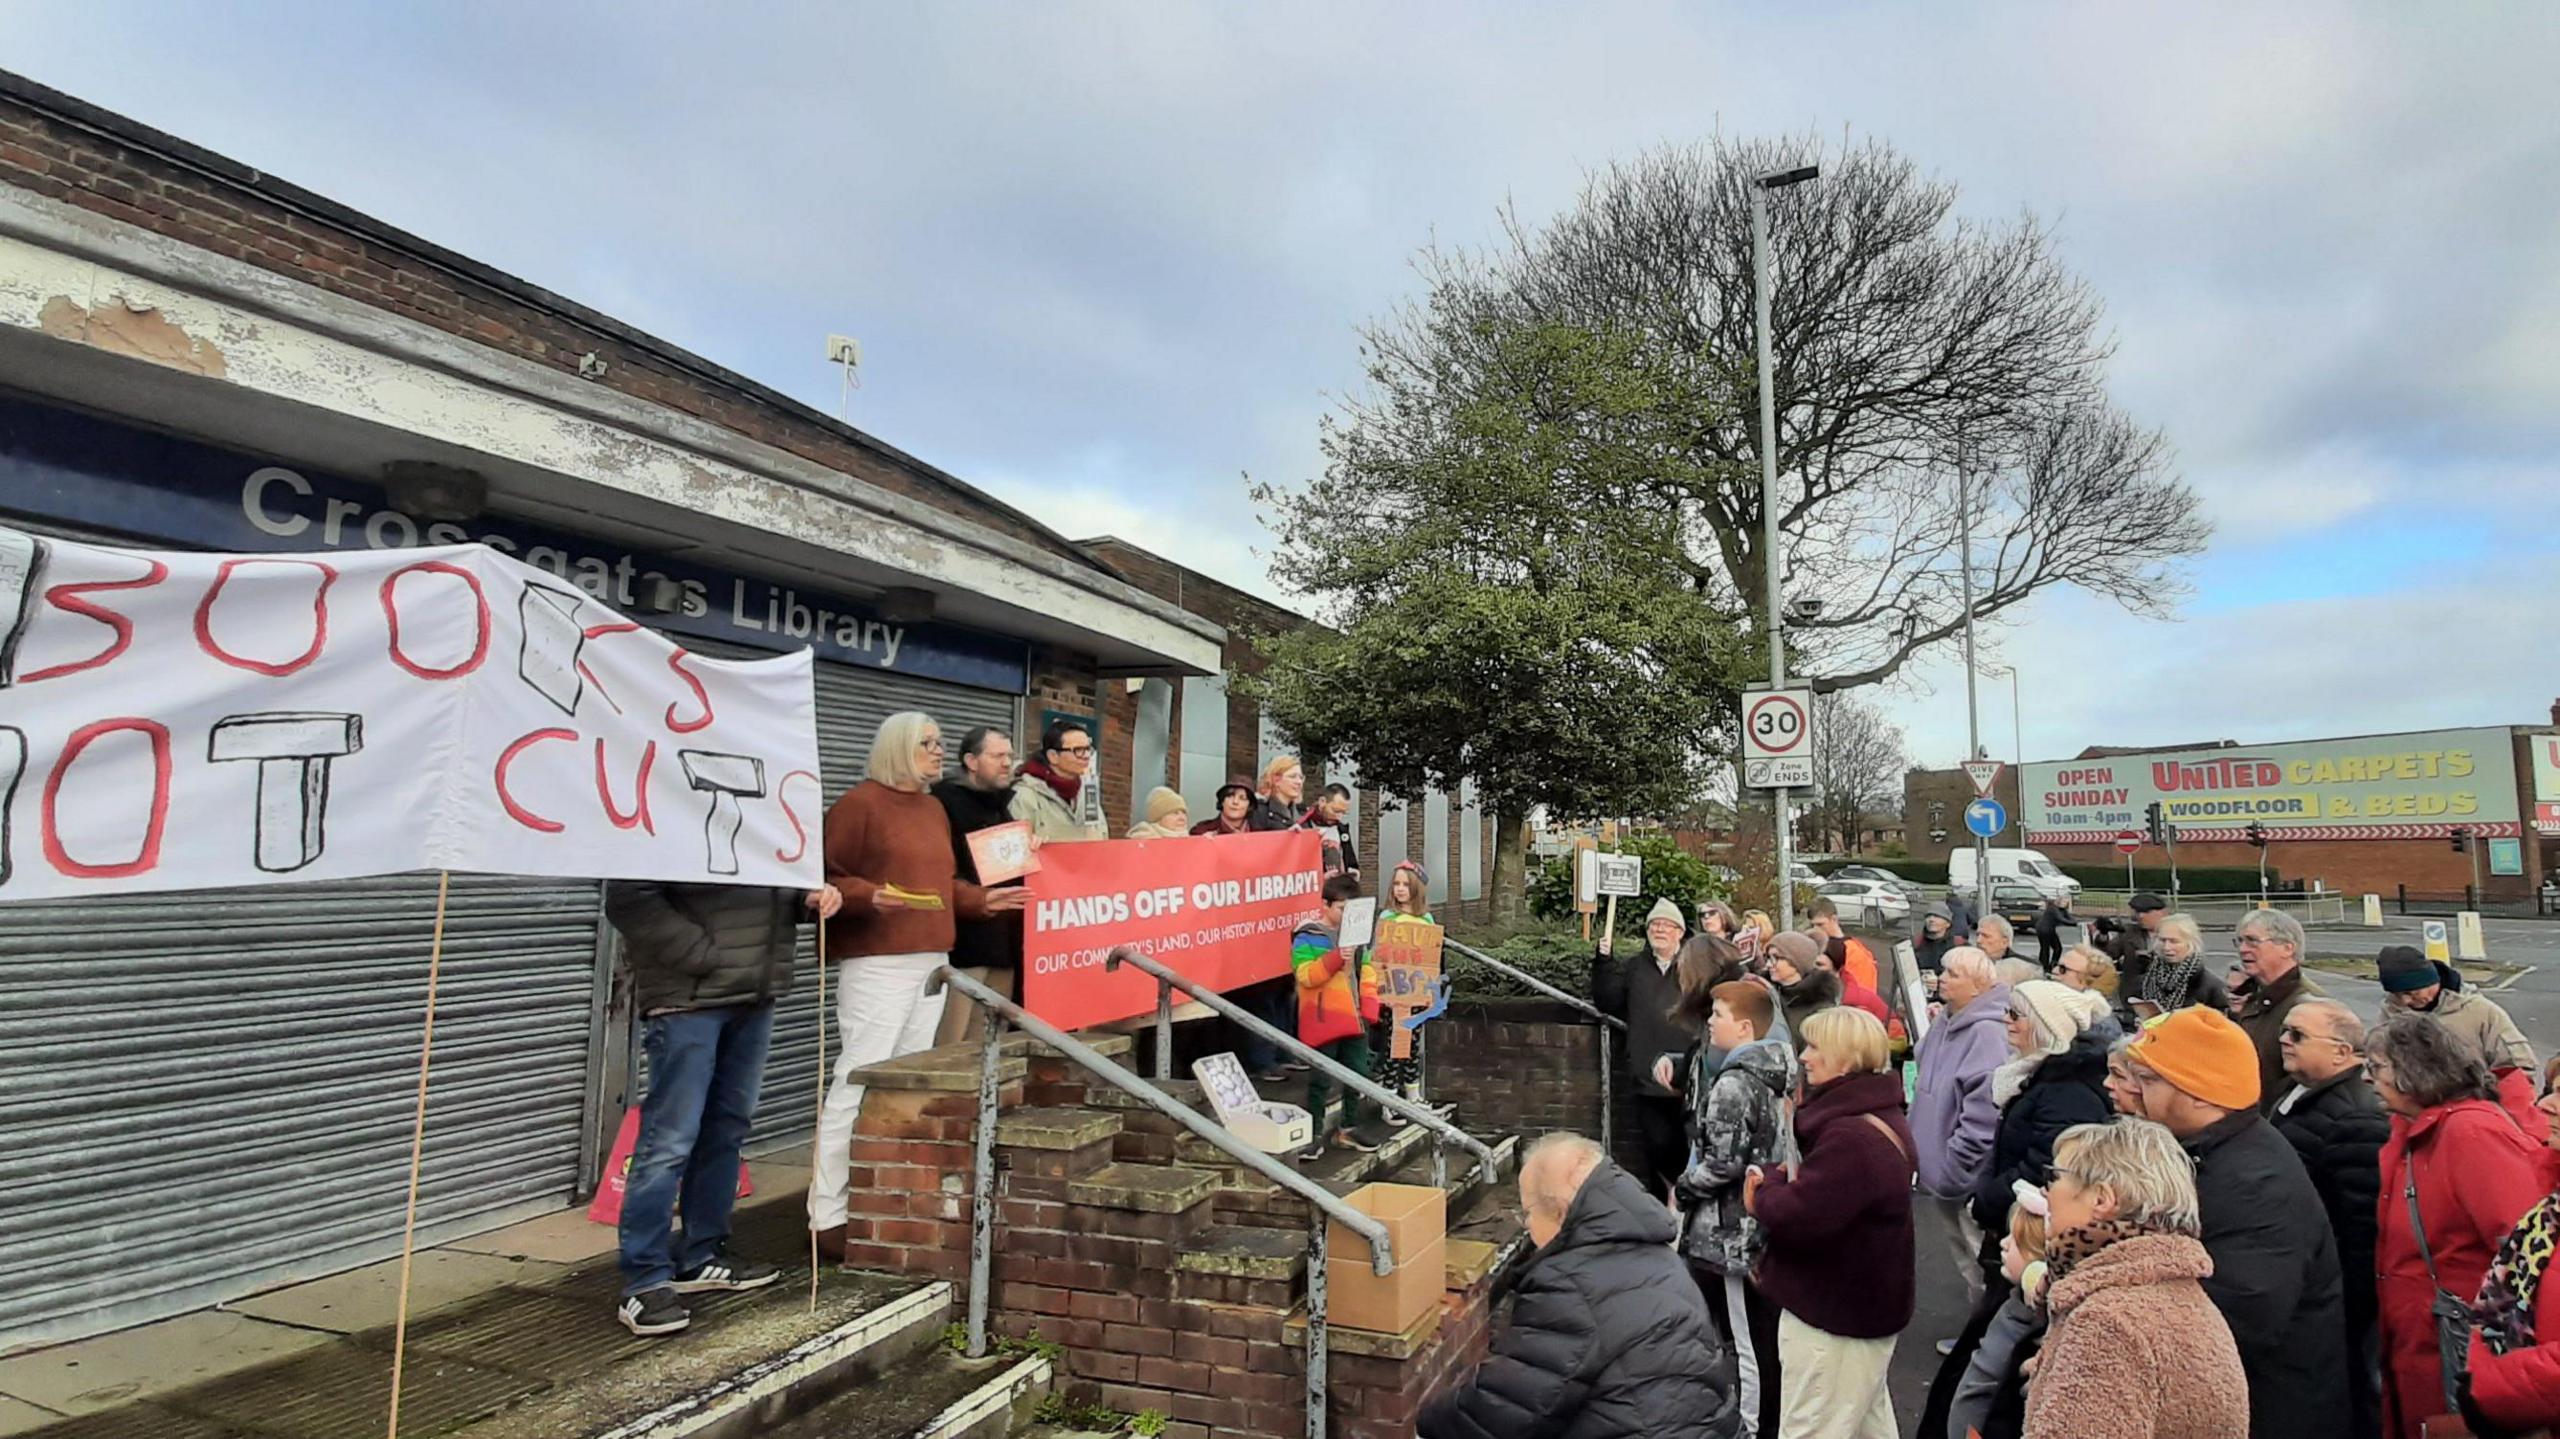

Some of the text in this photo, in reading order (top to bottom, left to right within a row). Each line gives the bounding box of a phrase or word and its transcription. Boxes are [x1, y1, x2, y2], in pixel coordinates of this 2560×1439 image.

[732, 576, 906, 667] Library
[1757, 711, 1797, 735] 30
[1774, 771, 1809, 782] ENDS
[1780, 762, 1802, 770] Zone
[1969, 765, 1994, 773] GIVE
[2057, 768, 2113, 786] OPEN
[2152, 750, 2475, 791] UNITED CARPETS
[0, 711, 820, 886] OT CUTS
[2044, 788, 2129, 808] SUNDAY
[2169, 791, 2479, 818] WOODFLOOR & BEDS
[2045, 809, 2132, 826] 10am-4pm
[1036, 870, 1319, 932] HANDS OFF OUR LIBRARY!
[1035, 953, 1068, 974] OUR
[1072, 938, 1153, 969] COMMTY'S
[1155, 931, 1194, 953] LAND,
[1196, 927, 1221, 946] OUR
[1221, 919, 1257, 941] HISTORY
[1257, 917, 1276, 933] AND
[1276, 913, 1293, 930] OUR
